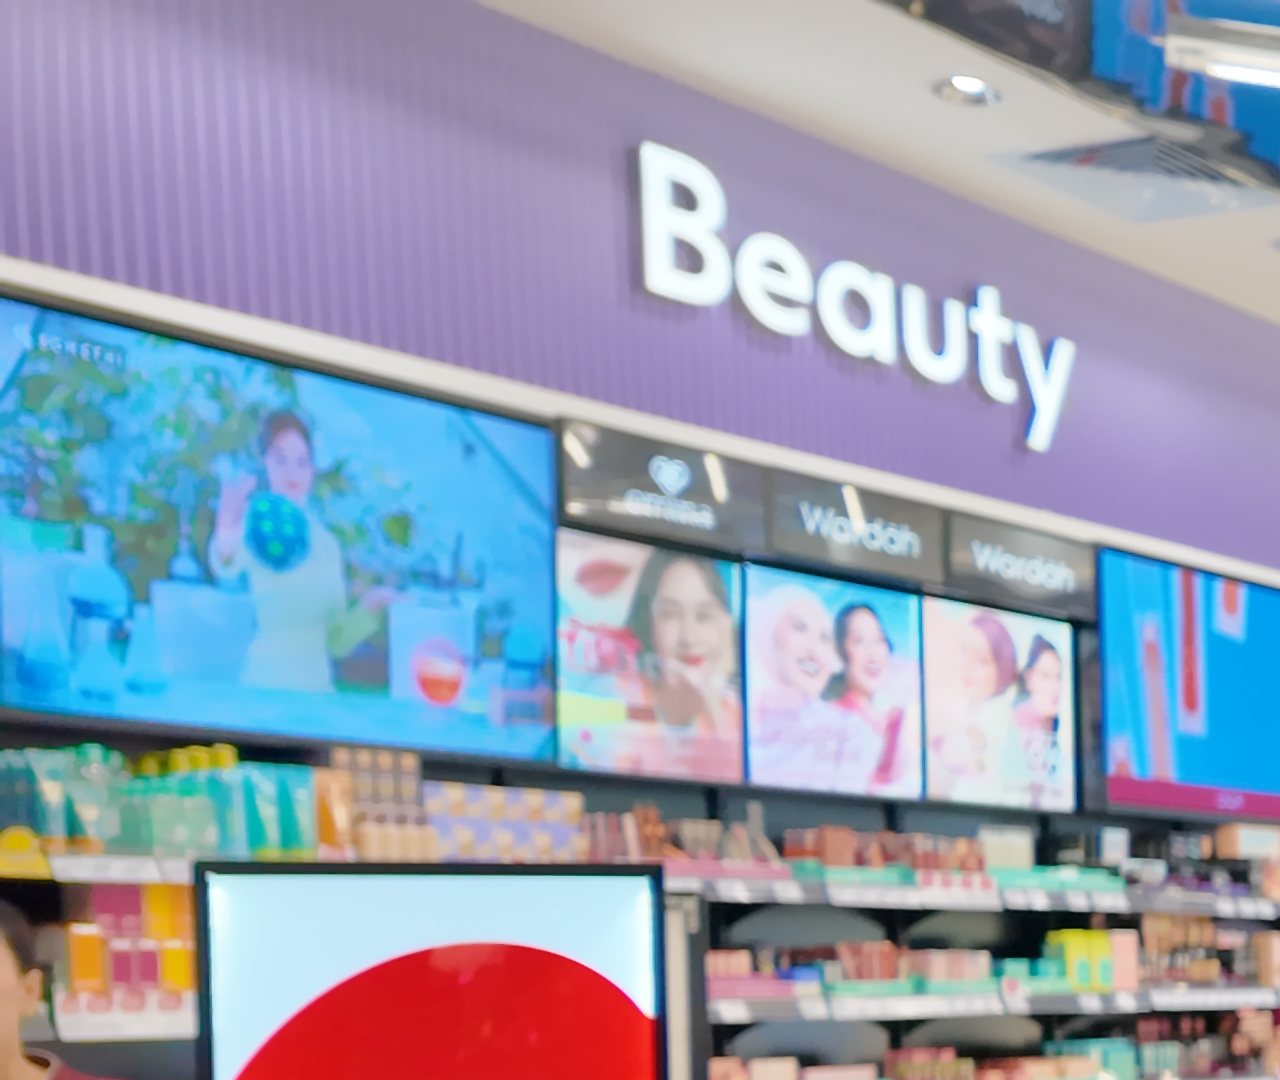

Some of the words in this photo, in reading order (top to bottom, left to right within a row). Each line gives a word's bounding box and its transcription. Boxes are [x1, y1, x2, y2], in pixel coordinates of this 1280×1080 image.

[639, 139, 1077, 453] Beauty
[799, 500, 922, 558] Wardah
[970, 538, 1076, 593] Wardah
